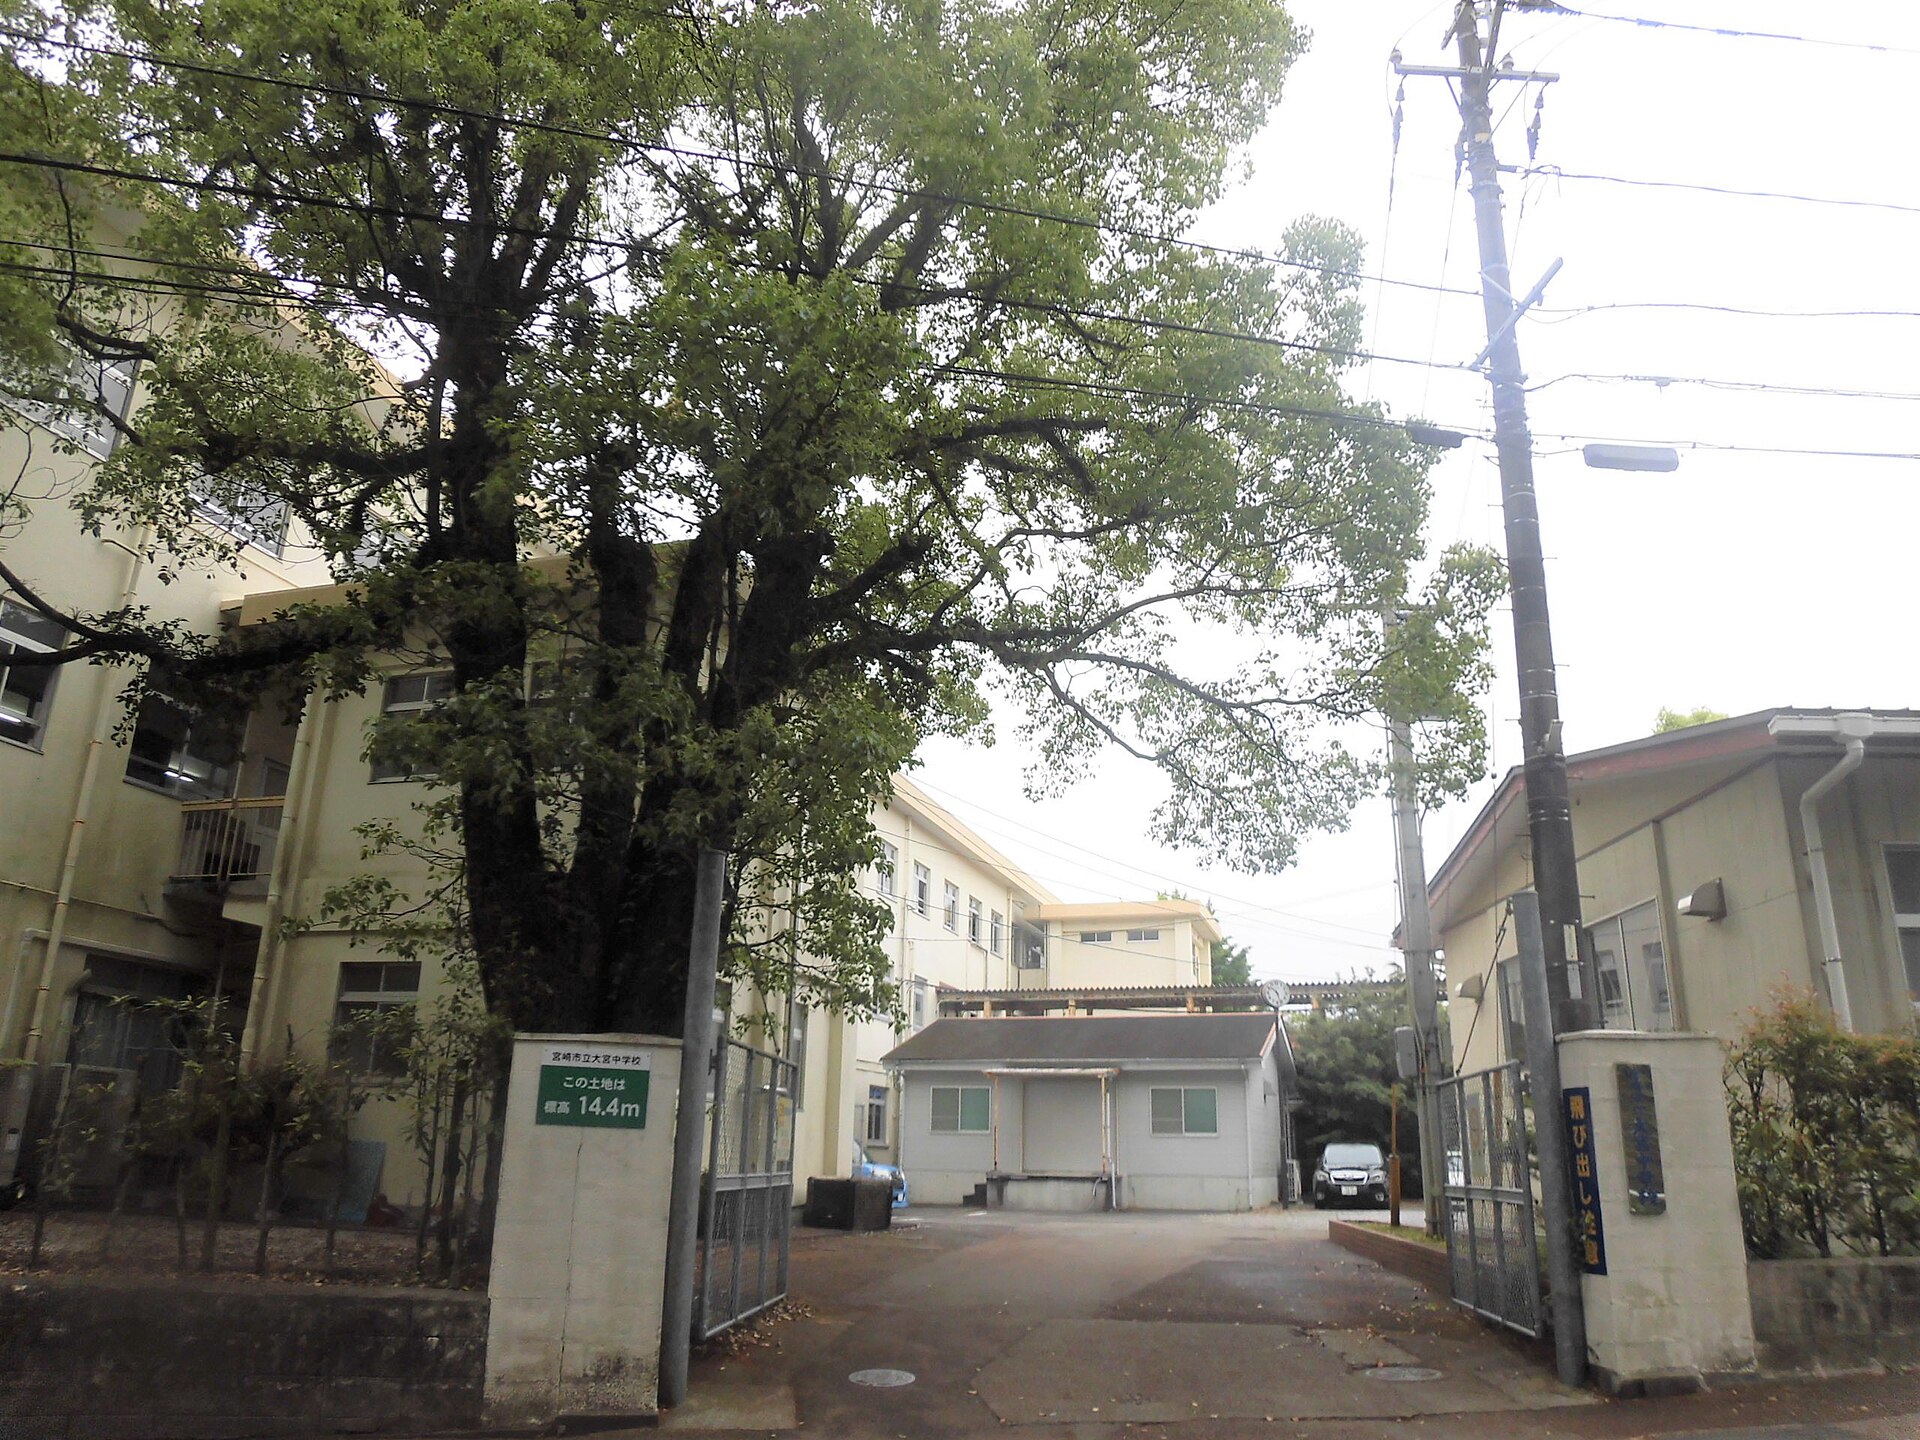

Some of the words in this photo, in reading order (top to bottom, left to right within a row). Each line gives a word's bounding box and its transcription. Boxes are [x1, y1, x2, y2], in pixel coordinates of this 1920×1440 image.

[552, 1051, 641, 1065] 宮崎市立大宮中学校
[563, 1077, 626, 1091] この土地は
[579, 1095, 640, 1117] 14.4m
